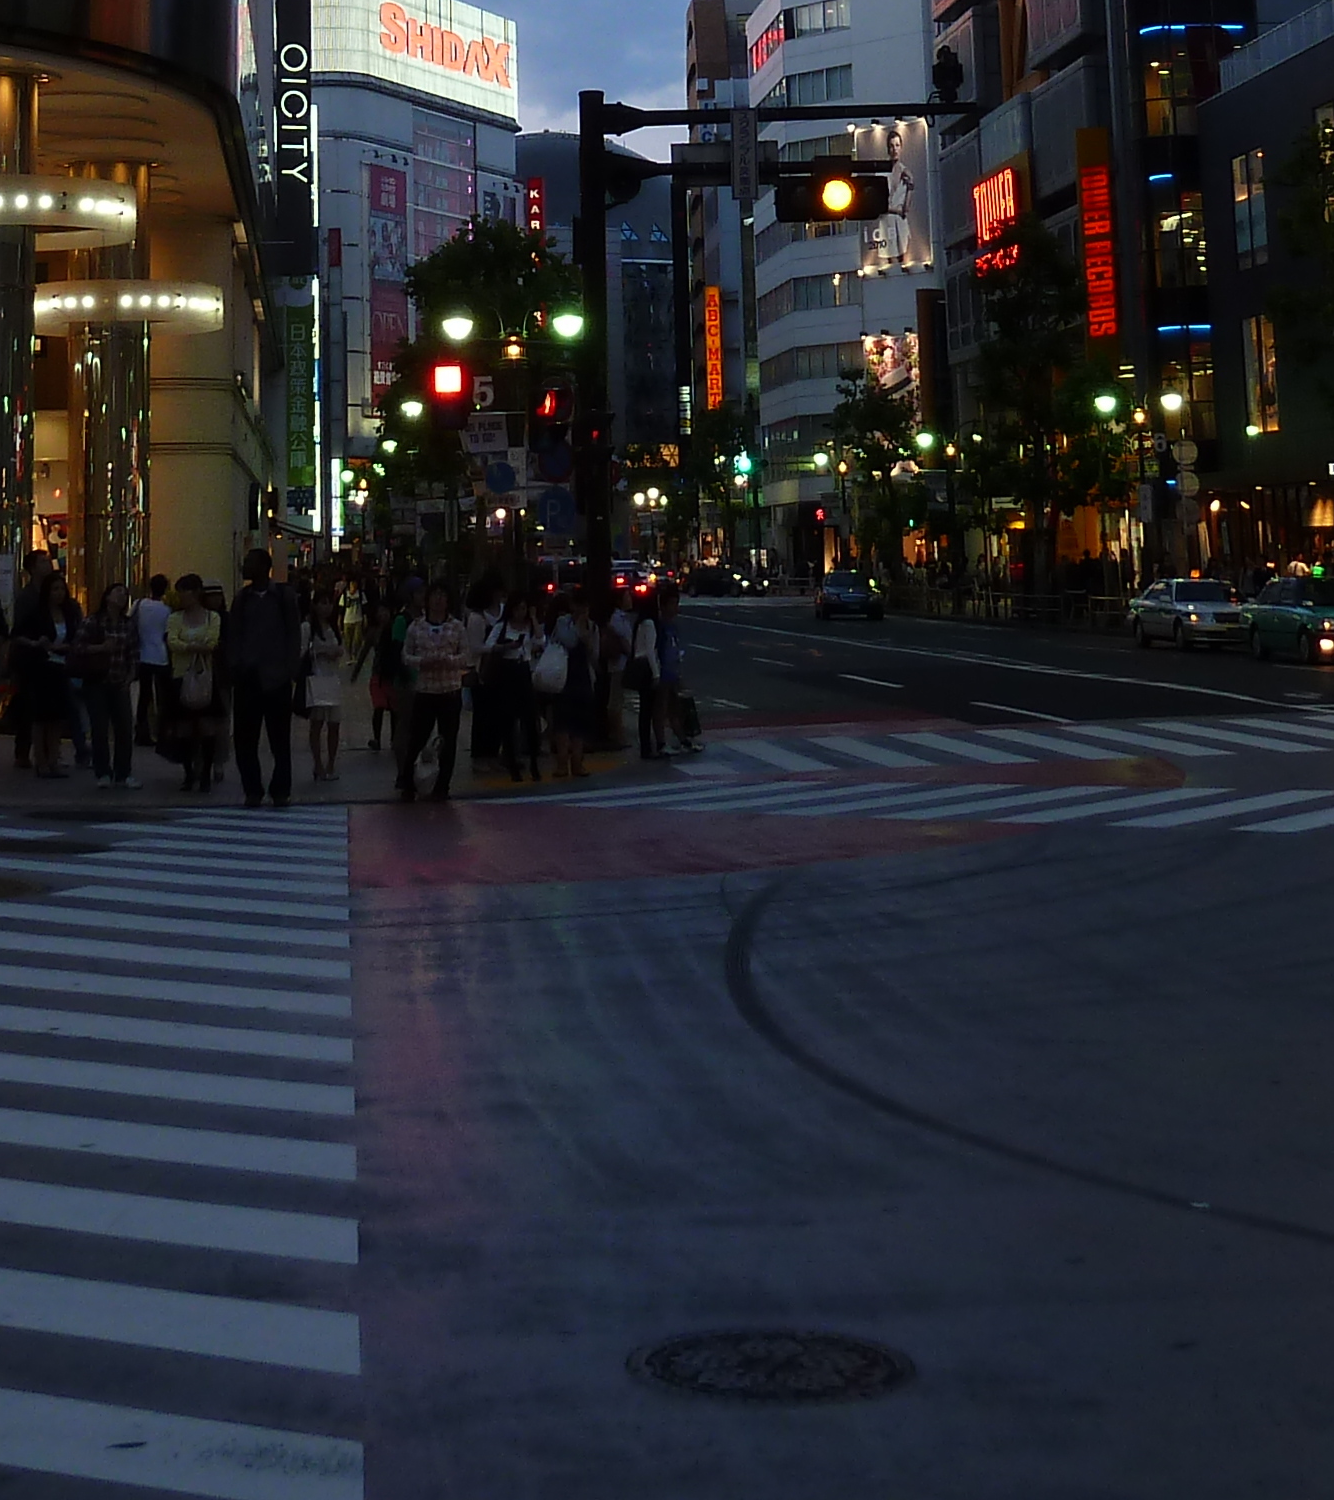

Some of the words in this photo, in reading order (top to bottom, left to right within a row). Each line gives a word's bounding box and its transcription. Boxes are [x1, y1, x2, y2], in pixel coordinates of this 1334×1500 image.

[379, 1, 511, 90] SHIDAX
[277, 42, 309, 184] OICITY
[1084, 240, 1117, 338] RECORDS
[472, 375, 496, 408] 5
